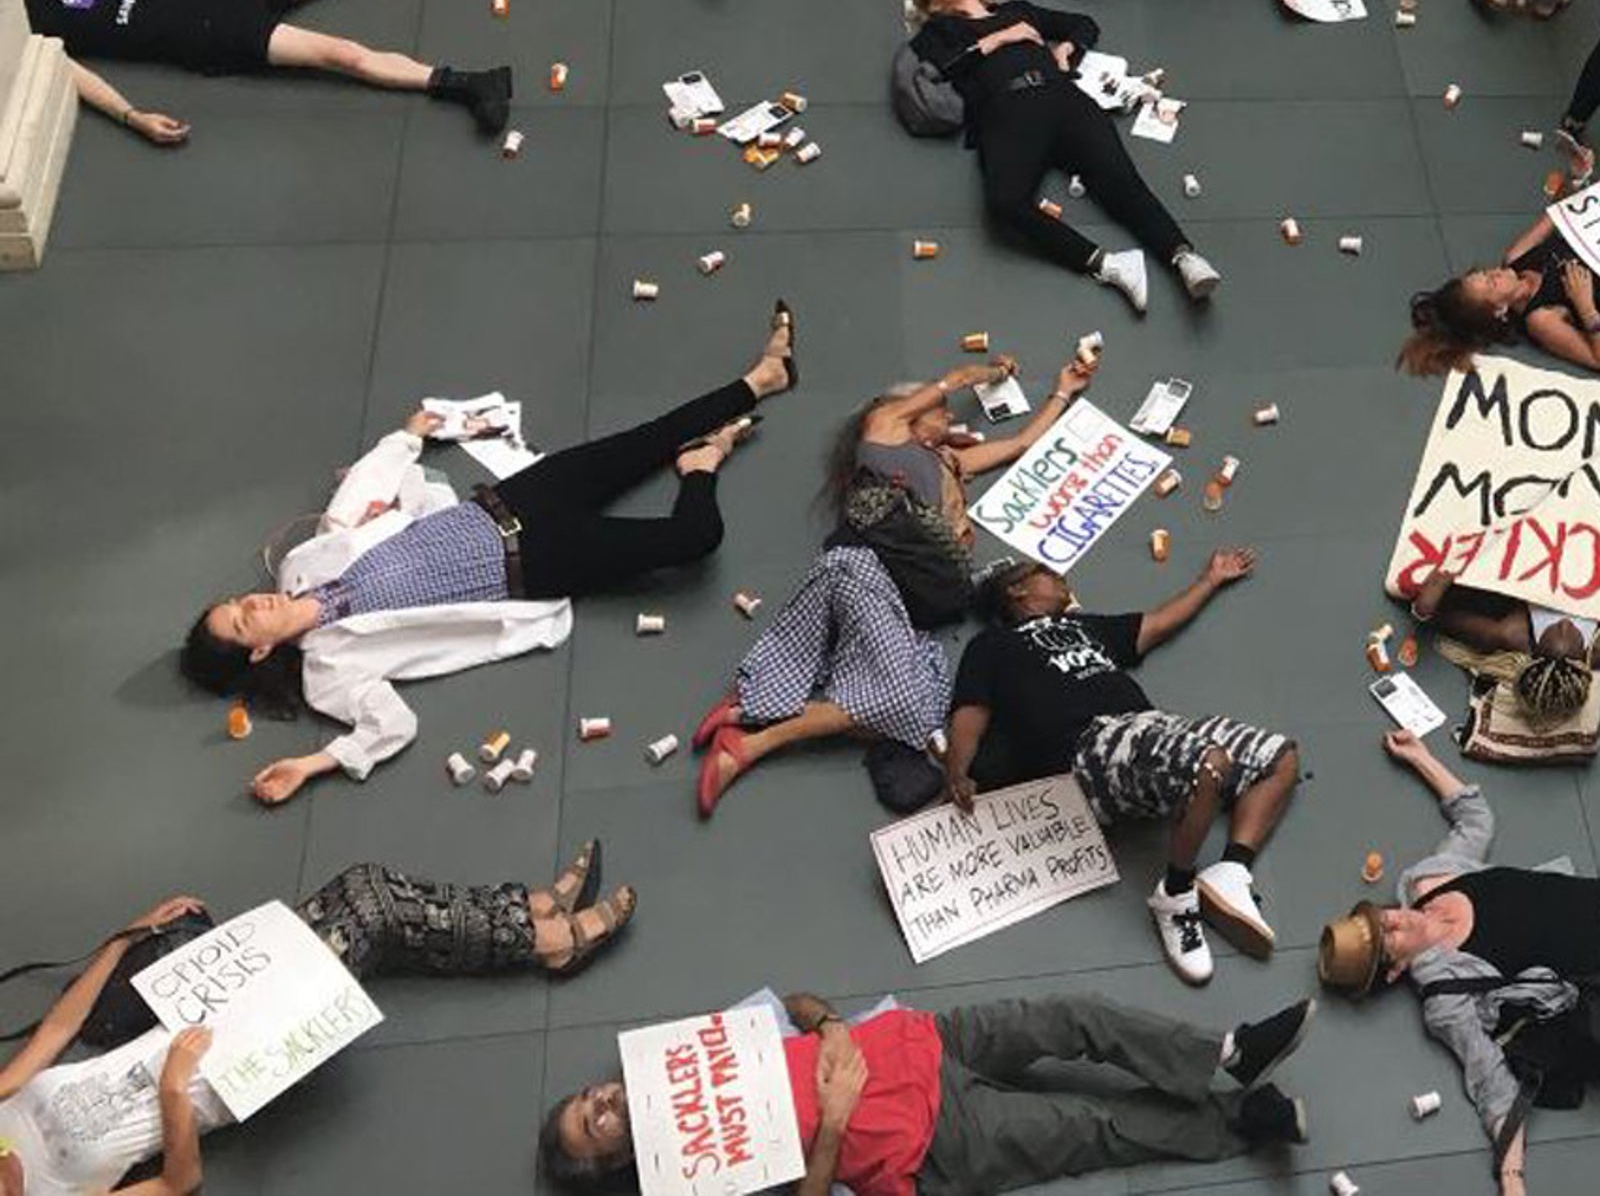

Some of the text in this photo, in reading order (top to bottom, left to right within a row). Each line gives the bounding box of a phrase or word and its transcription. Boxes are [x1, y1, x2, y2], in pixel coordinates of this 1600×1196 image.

[890, 787, 1060, 873] HUMAN LIVES
[900, 866, 944, 909] ARE
[949, 840, 1003, 882] MORE
[911, 900, 960, 941] THAN
[174, 945, 271, 1025] CRISIS
[664, 1043, 721, 1180] SACKLERS
[715, 1094, 754, 1167] MUST
